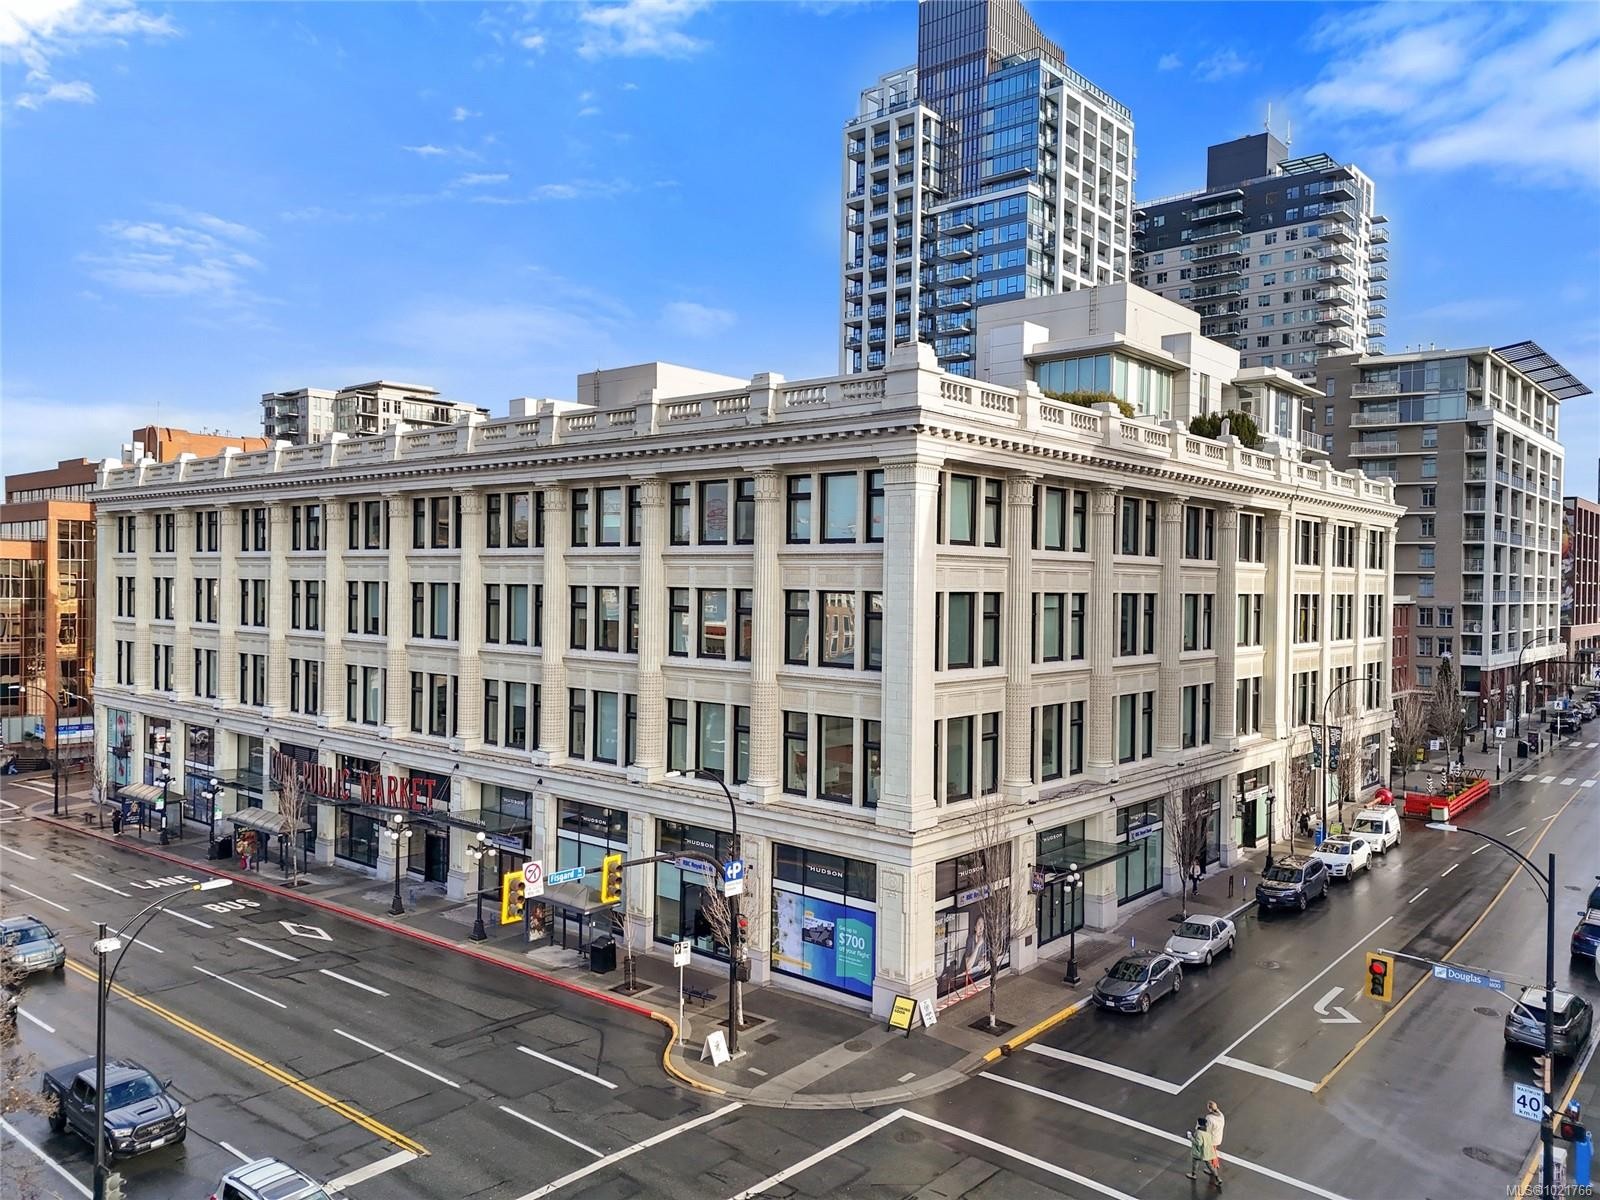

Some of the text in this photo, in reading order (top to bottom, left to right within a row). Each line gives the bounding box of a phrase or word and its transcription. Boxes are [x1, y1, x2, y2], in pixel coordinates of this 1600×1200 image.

[303, 761, 350, 801] PUBLIC
[360, 774, 436, 812] MARKET
[583, 816, 607, 825] HUDSON
[686, 839, 714, 849] HUDSON
[550, 870, 574, 884] Fisgard
[810, 866, 843, 878] HUDSON
[960, 865, 984, 877] HUDSON
[129, 875, 199, 889] LANE
[202, 898, 260, 913] BUS
[839, 932, 865, 950] $700
[1448, 969, 1482, 984] Douglas
[1516, 1094, 1540, 1112] 40
[1519, 1109, 1538, 1119] km/h
